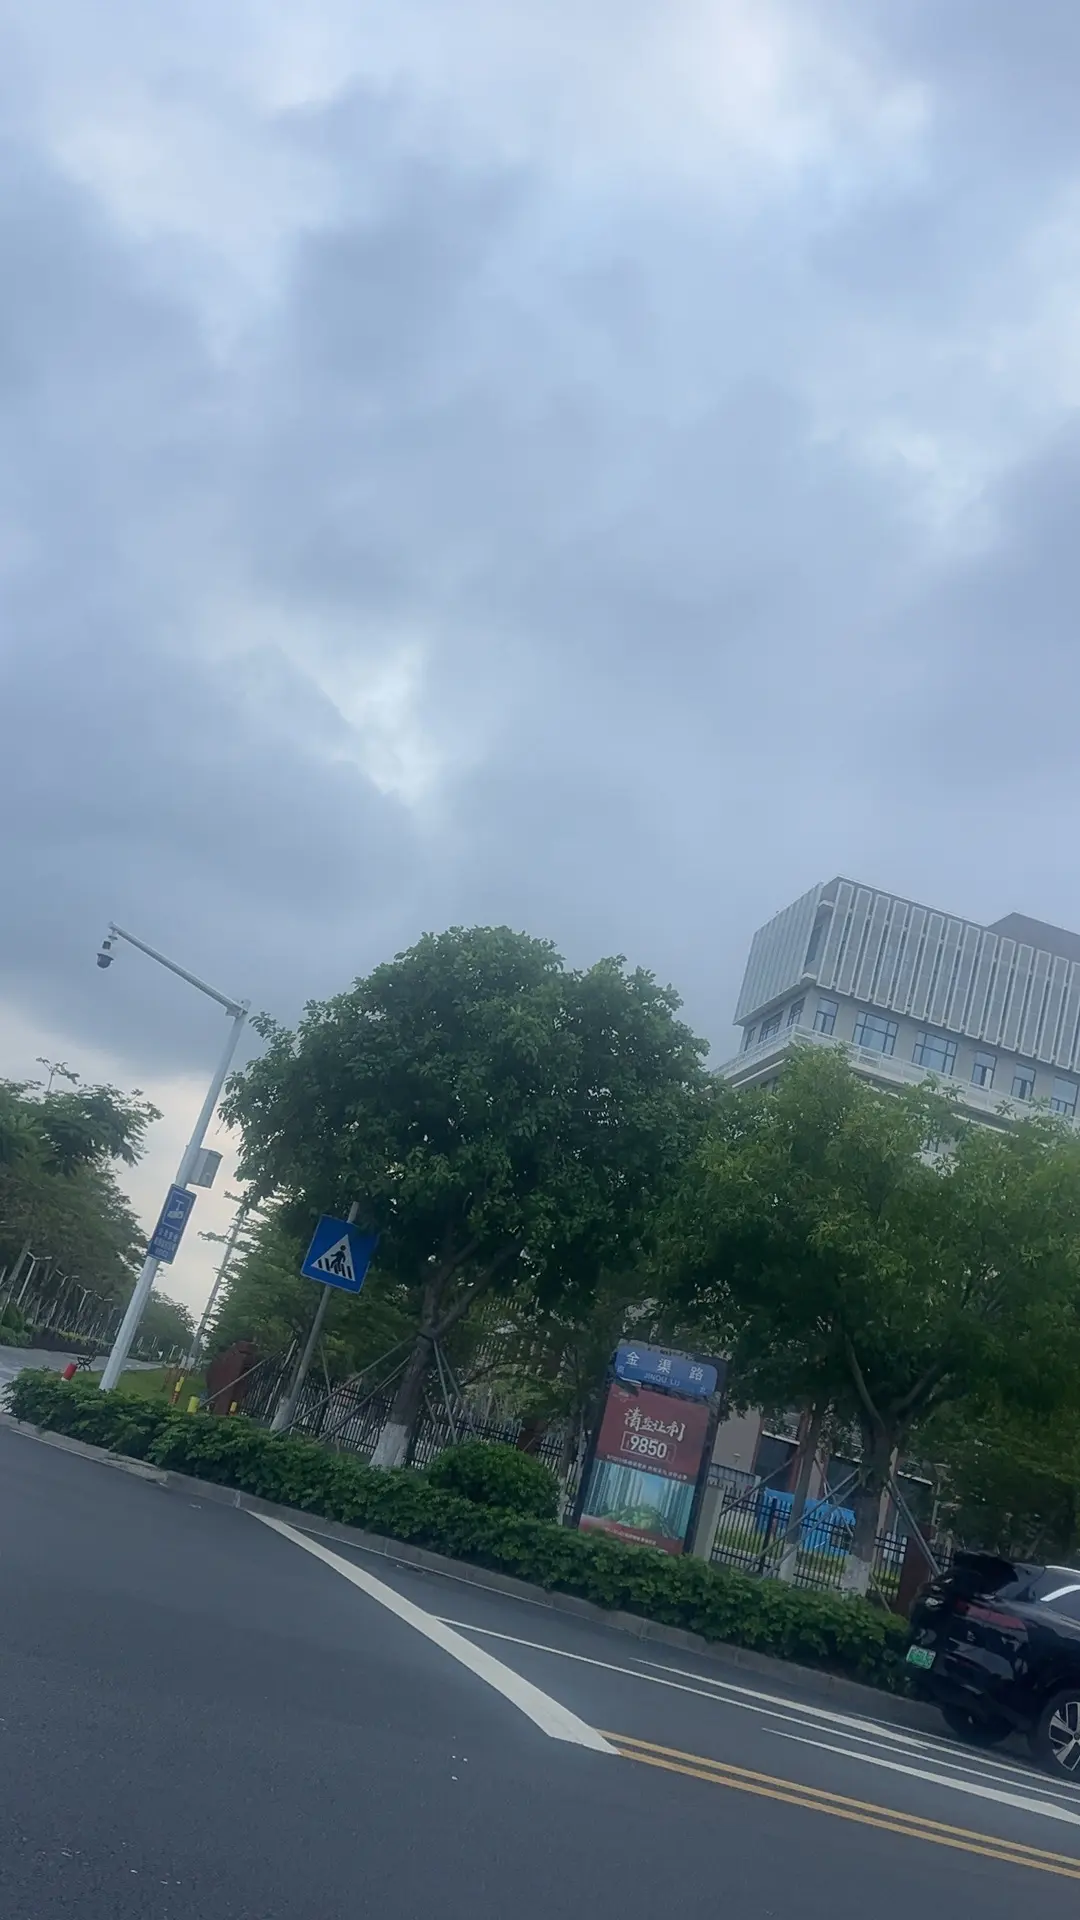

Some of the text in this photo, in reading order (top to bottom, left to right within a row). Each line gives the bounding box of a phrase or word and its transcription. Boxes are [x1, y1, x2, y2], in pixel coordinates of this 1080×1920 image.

[625, 1351, 704, 1382] 金渠路
[643, 1372, 681, 1387] JINQU LU
[630, 1435, 668, 1459] 9850
